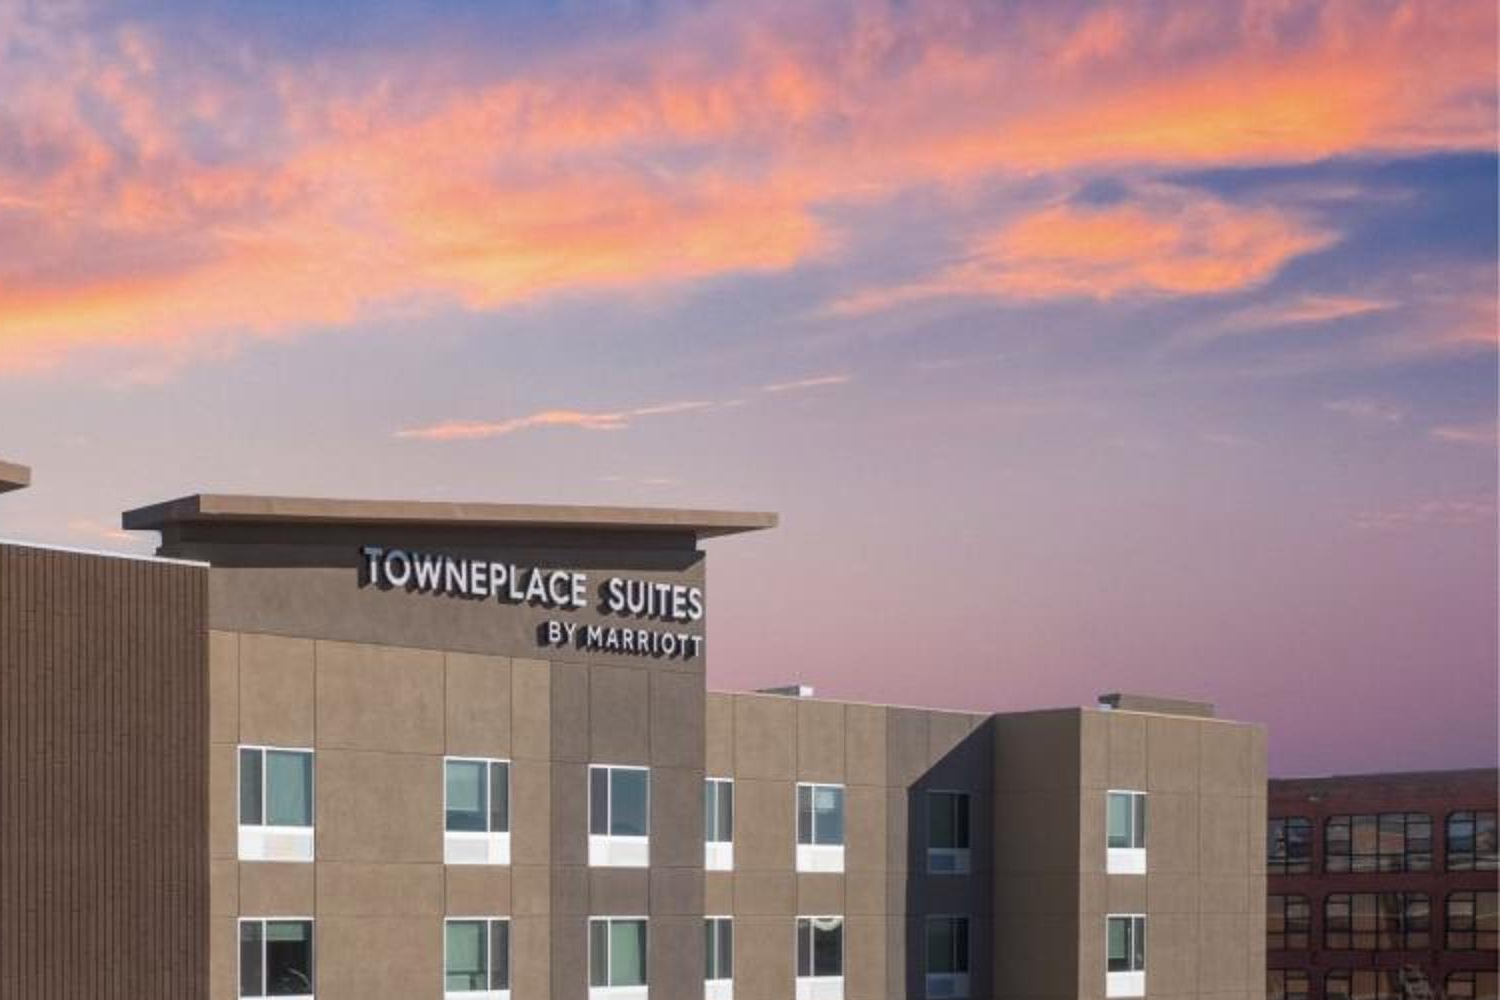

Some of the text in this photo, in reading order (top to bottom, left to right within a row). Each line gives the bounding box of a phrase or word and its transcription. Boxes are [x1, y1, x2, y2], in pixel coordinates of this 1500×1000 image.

[364, 546, 703, 620] TOWNEPLACE SUITES
[548, 620, 703, 657] BY MARRIOTT
